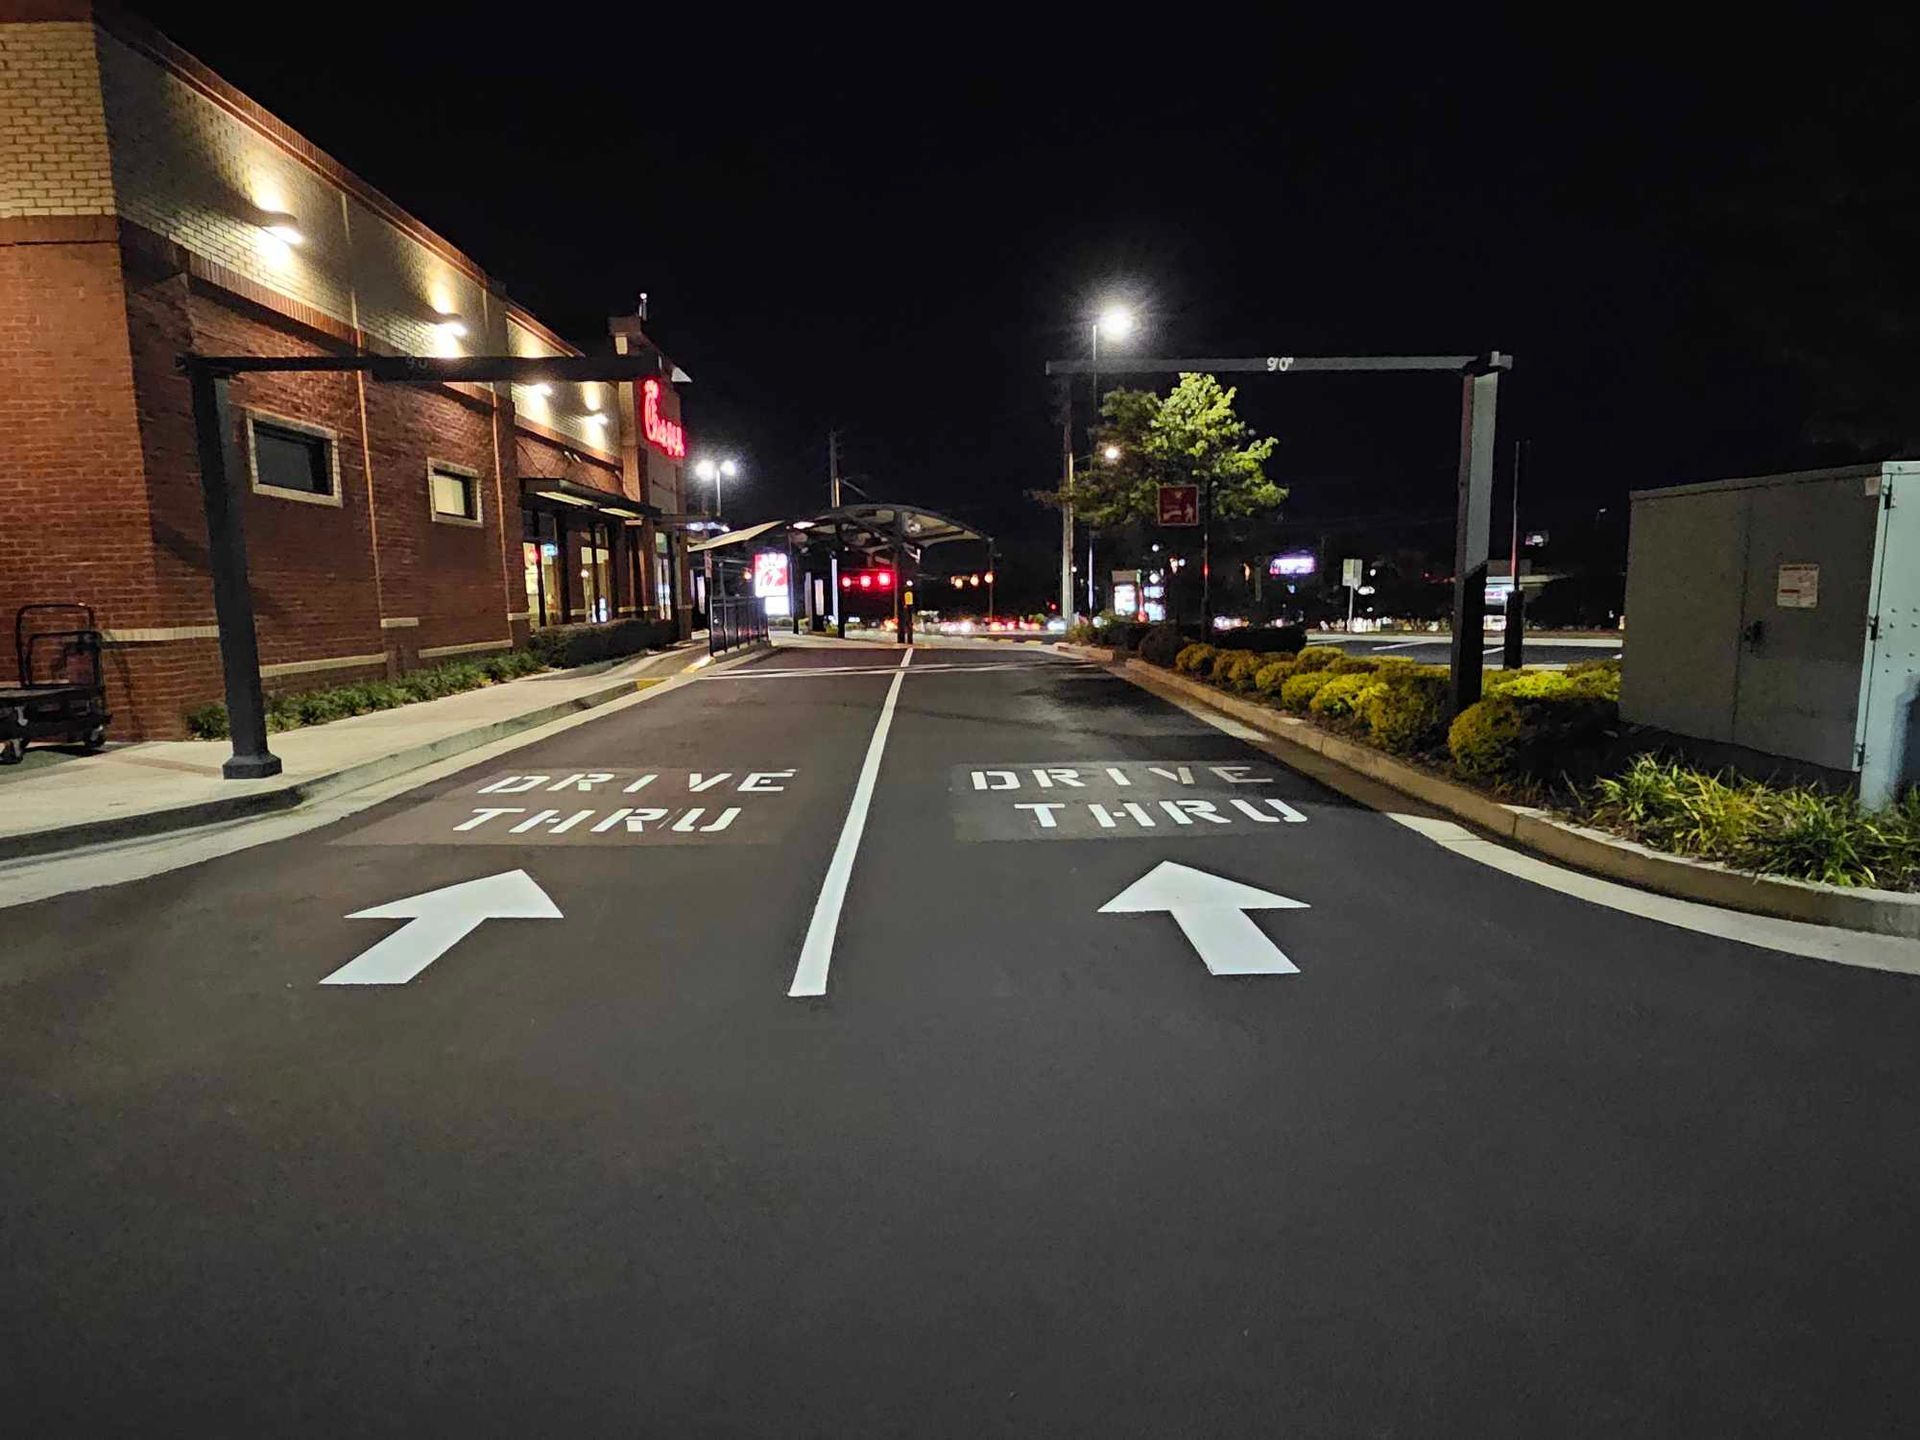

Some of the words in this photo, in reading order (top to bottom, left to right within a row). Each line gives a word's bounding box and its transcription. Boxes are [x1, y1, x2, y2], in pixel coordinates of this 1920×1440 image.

[477, 768, 796, 794] DRIVE
[970, 765, 1274, 791] DRIVE
[452, 807, 742, 834] THRU
[1013, 797, 1308, 828] THRU
